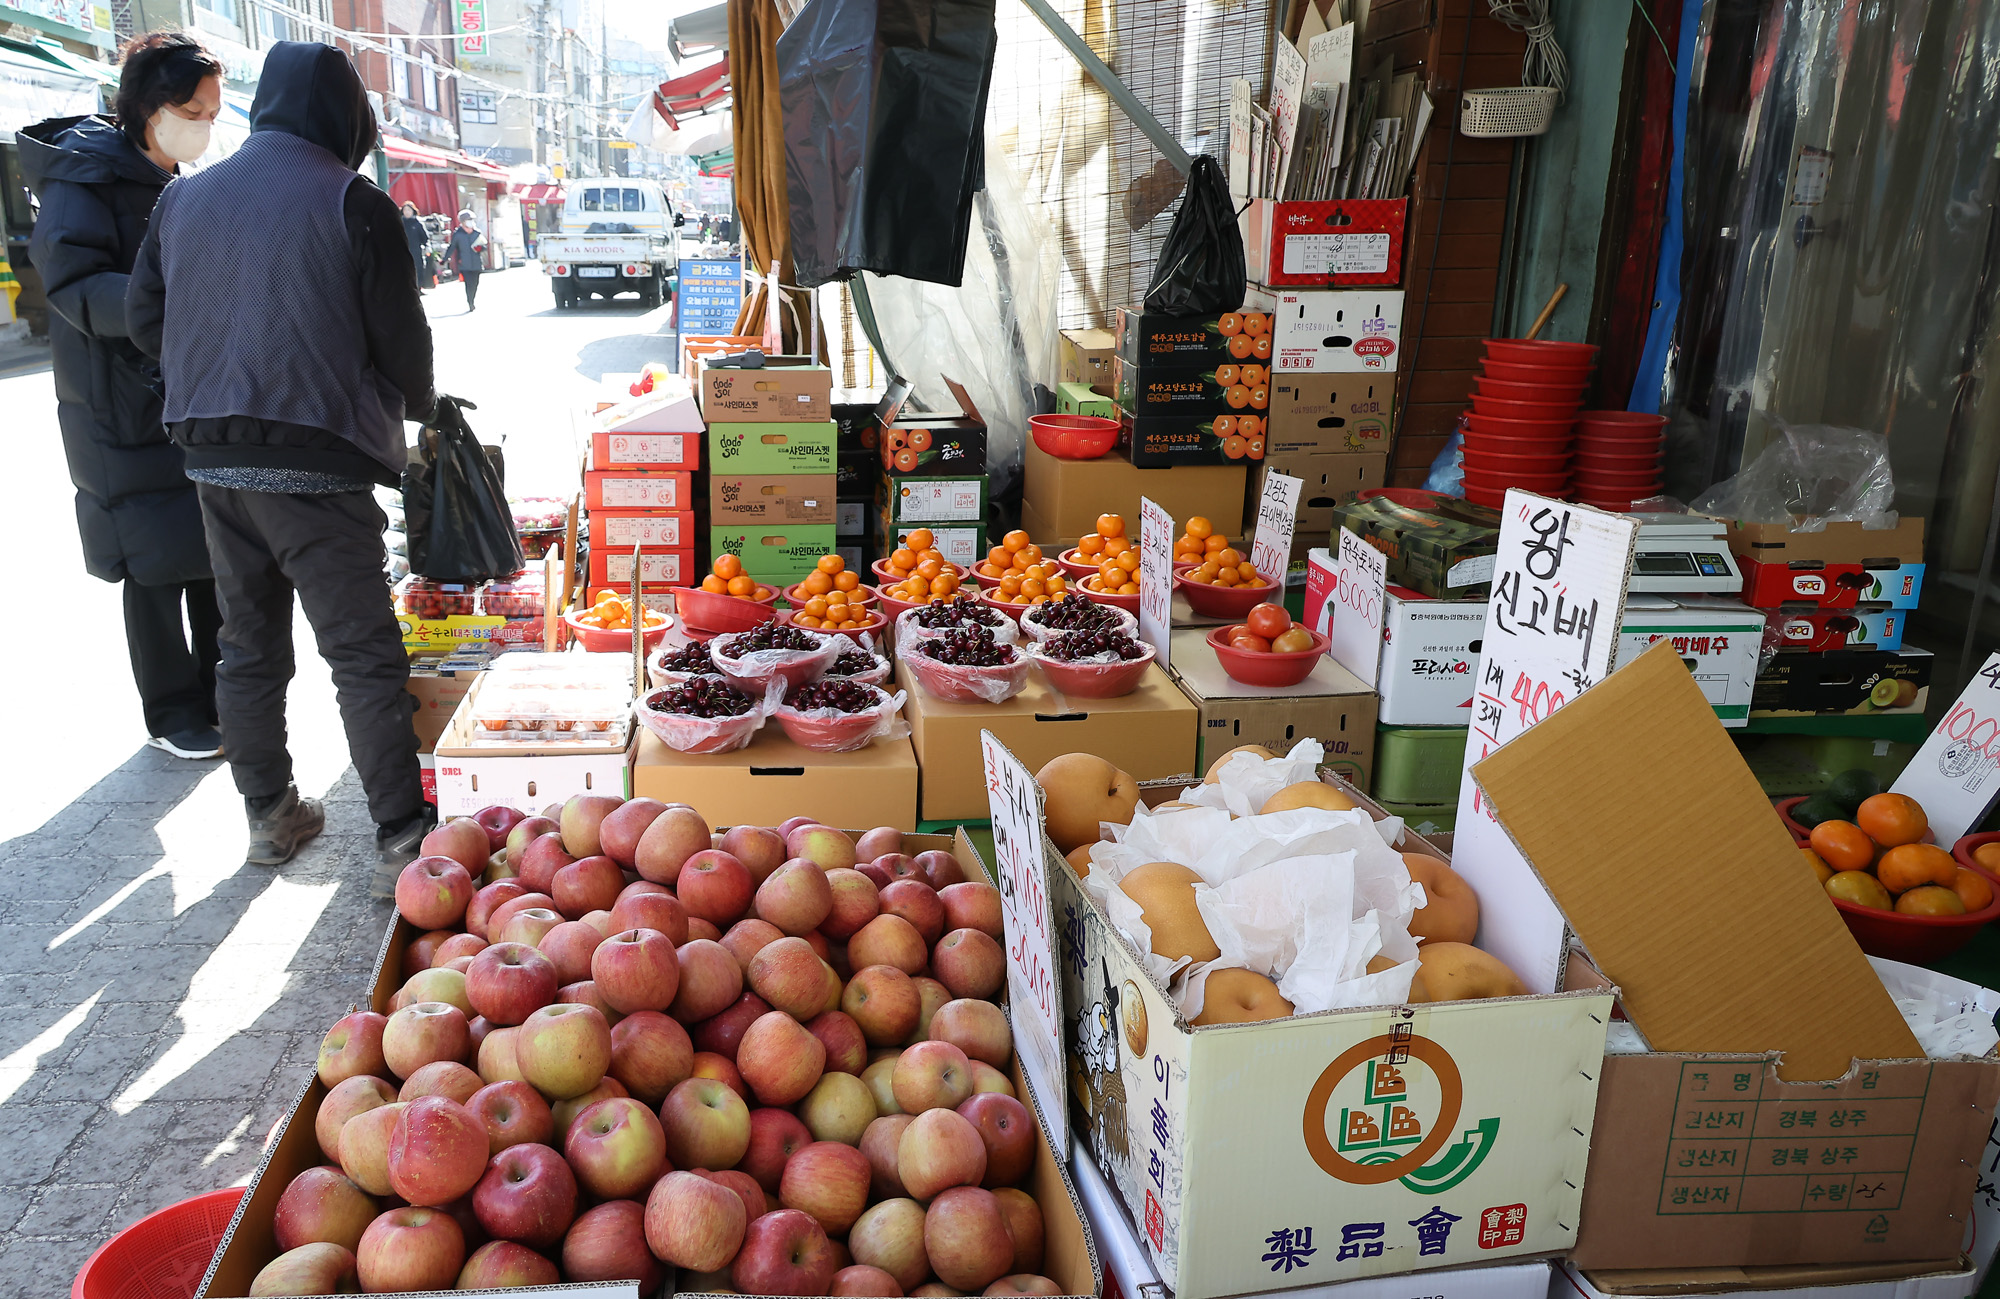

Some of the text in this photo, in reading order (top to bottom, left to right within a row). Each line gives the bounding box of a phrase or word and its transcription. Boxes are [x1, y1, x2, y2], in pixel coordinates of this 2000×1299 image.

[692, 264, 733, 276] 금거래소
[686, 296, 735, 306] 오늘의 금시세
[1151, 333, 1206, 342] 제주고당도감귤
[1148, 383, 1203, 392] 제주고당도감귤
[724, 401, 759, 409] 샤인머스켓
[1146, 434, 1201, 443] 제주고당도감귤
[790, 446, 830, 456] 샤인머스켓
[1522, 507, 1575, 580] 왕
[790, 547, 830, 556] 샤인머스켓
[1342, 535, 1384, 589] 완숙토마토
[1797, 582, 1821, 591] Dole
[1494, 571, 1598, 672] 신고배
[1787, 627, 1810, 636] Dole
[1485, 658, 1503, 698] 1개
[1207, 719, 1227, 727] 13KG
[1478, 700, 1501, 740] 3개
[441, 767, 462, 775] 13KG
[994, 814, 1009, 858] 6개
[998, 859, 1017, 912] 13개
[1733, 1073, 1752, 1091] 명
[1861, 1071, 1880, 1089] 감
[1779, 1110, 1817, 1128] 경북
[1829, 1109, 1867, 1127] 상주
[1771, 1148, 1809, 1166] 경북
[1820, 1147, 1859, 1165] 상주
[1671, 1186, 1730, 1205] 생산자
[1808, 1184, 1848, 1201] 수량
